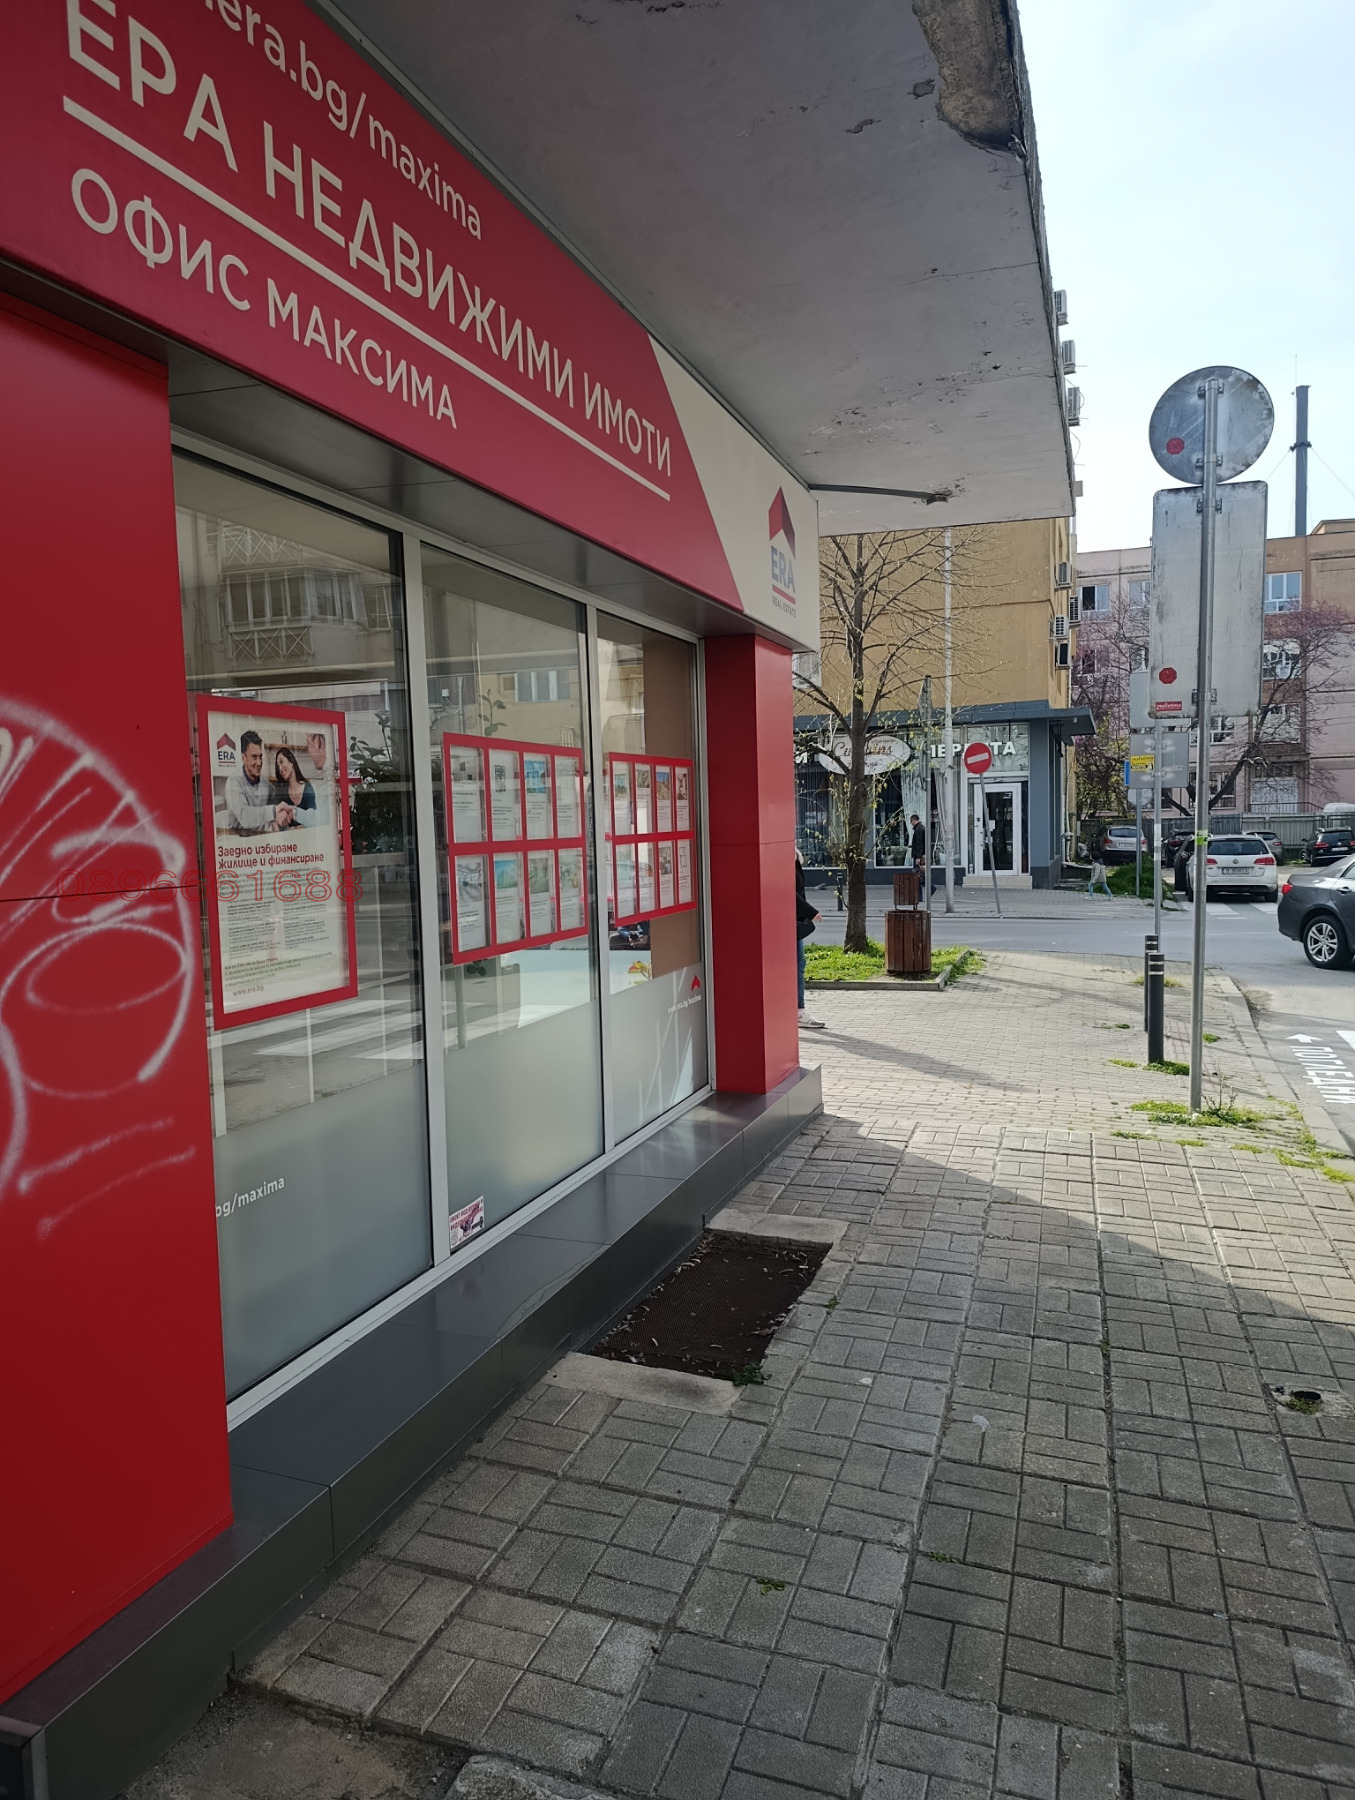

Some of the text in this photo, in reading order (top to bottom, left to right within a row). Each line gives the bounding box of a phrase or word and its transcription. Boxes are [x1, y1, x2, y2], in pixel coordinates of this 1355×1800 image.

[66, 0, 671, 477] ЕРА НЕДВИЖИМИ ИМОТИ
[71, 168, 457, 429] ОФИС МАКСИМА
[771, 545, 796, 594] ERA
[772, 595, 797, 618] REAL ESTATE
[217, 751, 236, 761] ERA
[218, 843, 298, 857] Заедно избираме
[218, 853, 324, 869] жилище и финансиране
